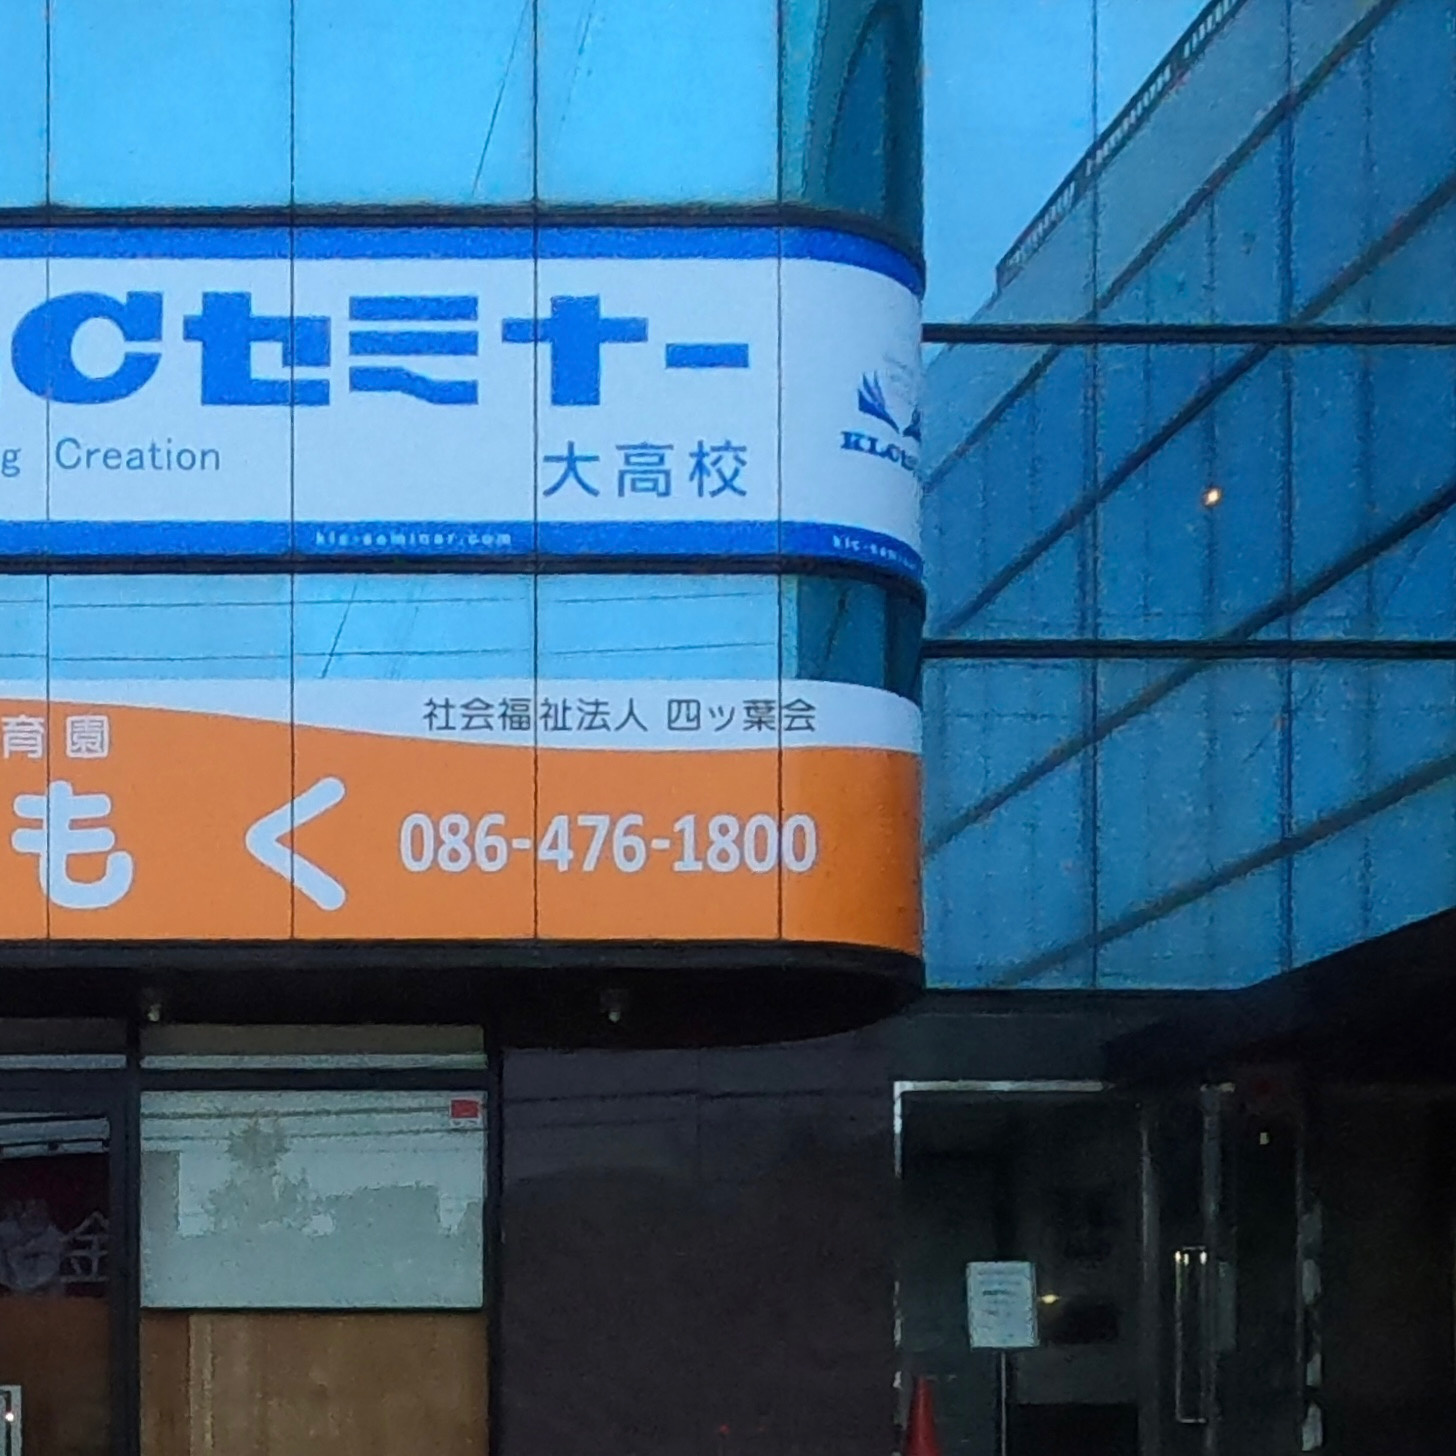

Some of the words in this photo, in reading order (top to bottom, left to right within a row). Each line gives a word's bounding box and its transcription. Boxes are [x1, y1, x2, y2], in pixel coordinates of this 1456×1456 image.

[55, 437, 221, 471] Creation
[542, 440, 749, 498] 大高校
[422, 697, 648, 733] 社会福祉法人
[399, 813, 819, 873] 086-476-1800
